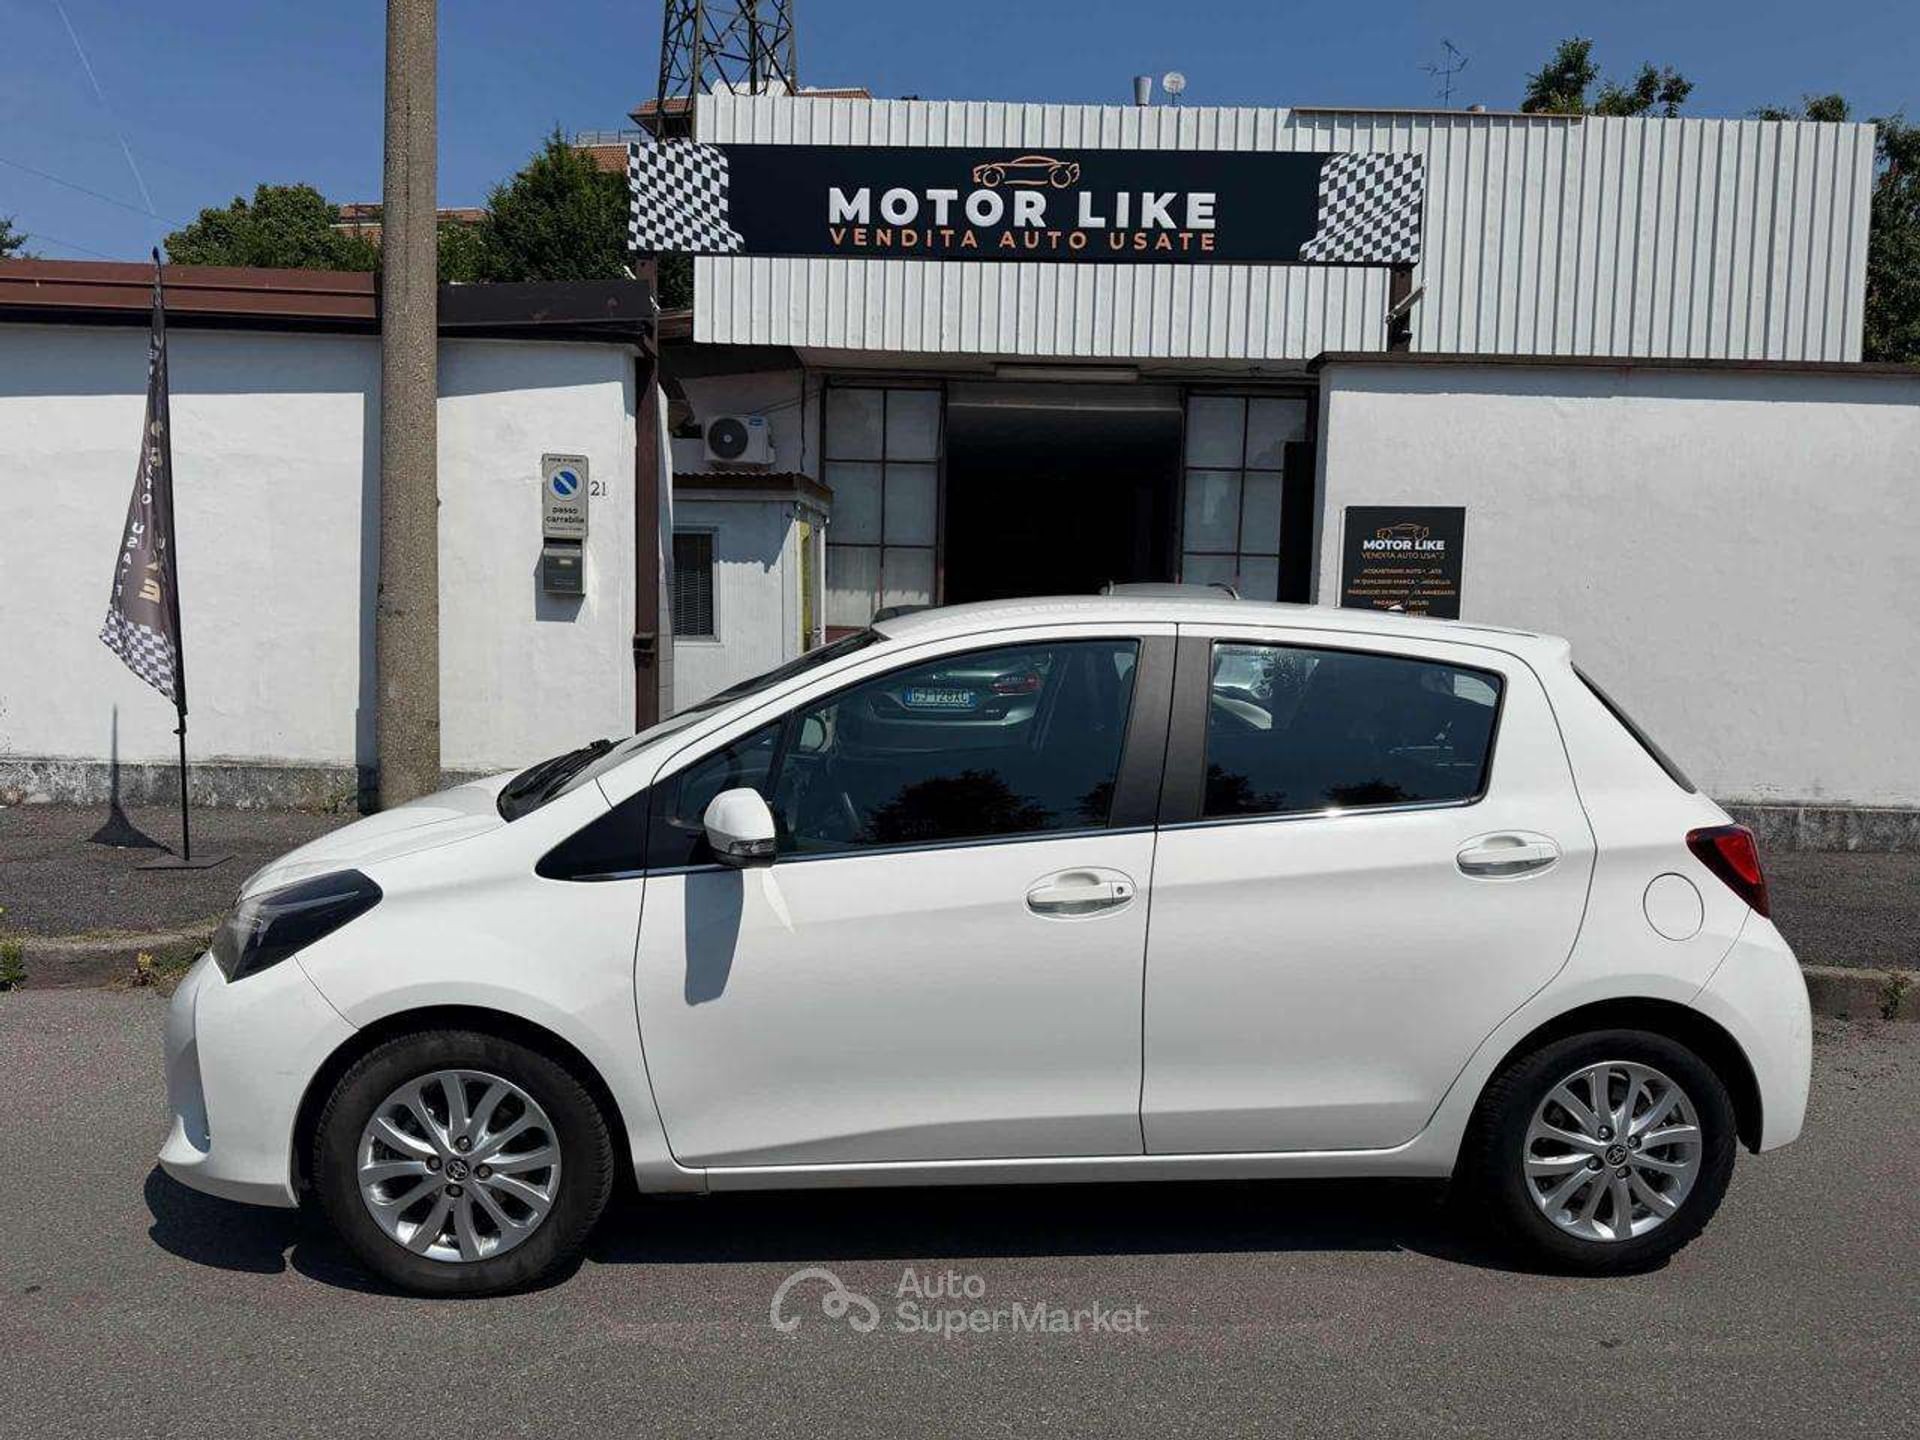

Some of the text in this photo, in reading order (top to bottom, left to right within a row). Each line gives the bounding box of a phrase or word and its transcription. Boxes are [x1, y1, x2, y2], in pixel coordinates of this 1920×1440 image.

[829, 187, 1216, 229] MOTOR LIKE
[830, 228, 1215, 250] VENDITA AUTO USATE
[590, 480, 607, 497] 21
[552, 506, 578, 515] passo
[546, 514, 585, 524] carrabile
[1363, 540, 1445, 550] MOTOR LIKE
[1361, 551, 1395, 559] VENDITA
[1397, 551, 1418, 559] AUTO
